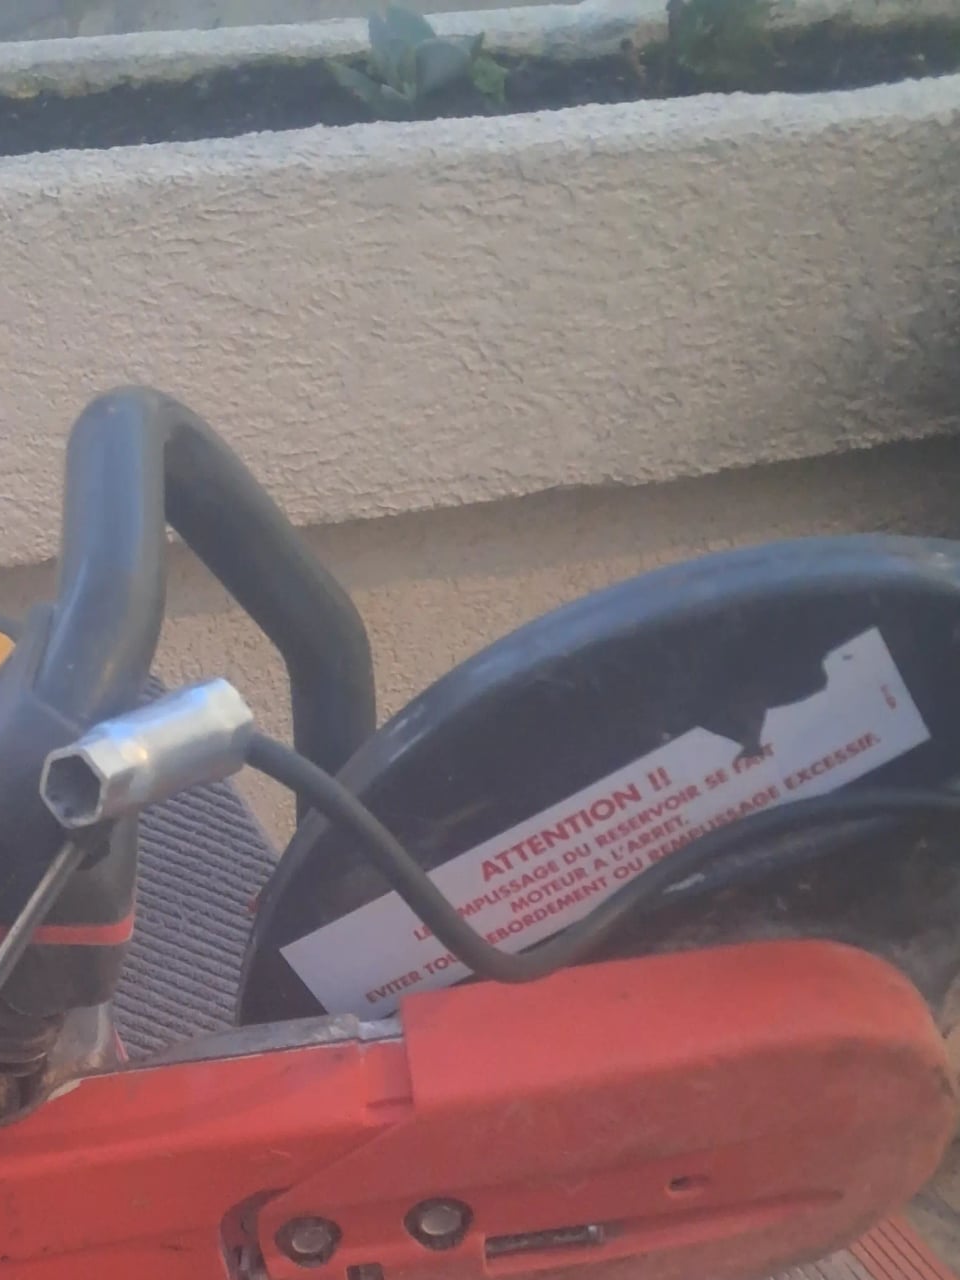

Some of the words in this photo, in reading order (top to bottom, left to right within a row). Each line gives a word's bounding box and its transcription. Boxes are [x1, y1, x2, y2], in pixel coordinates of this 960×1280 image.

[476, 780, 643, 883] ATTENTION
[561, 841, 592, 866] DU
[593, 782, 701, 849] RESERVOIR
[702, 768, 729, 790] SE
[364, 967, 422, 1006] EVITER
[484, 874, 609, 946] EBORDEMENT
[611, 856, 644, 882] OU
[646, 784, 781, 864] REMPLISSAGE
[508, 865, 588, 914] MOTEUR
[590, 854, 609, 872] A
